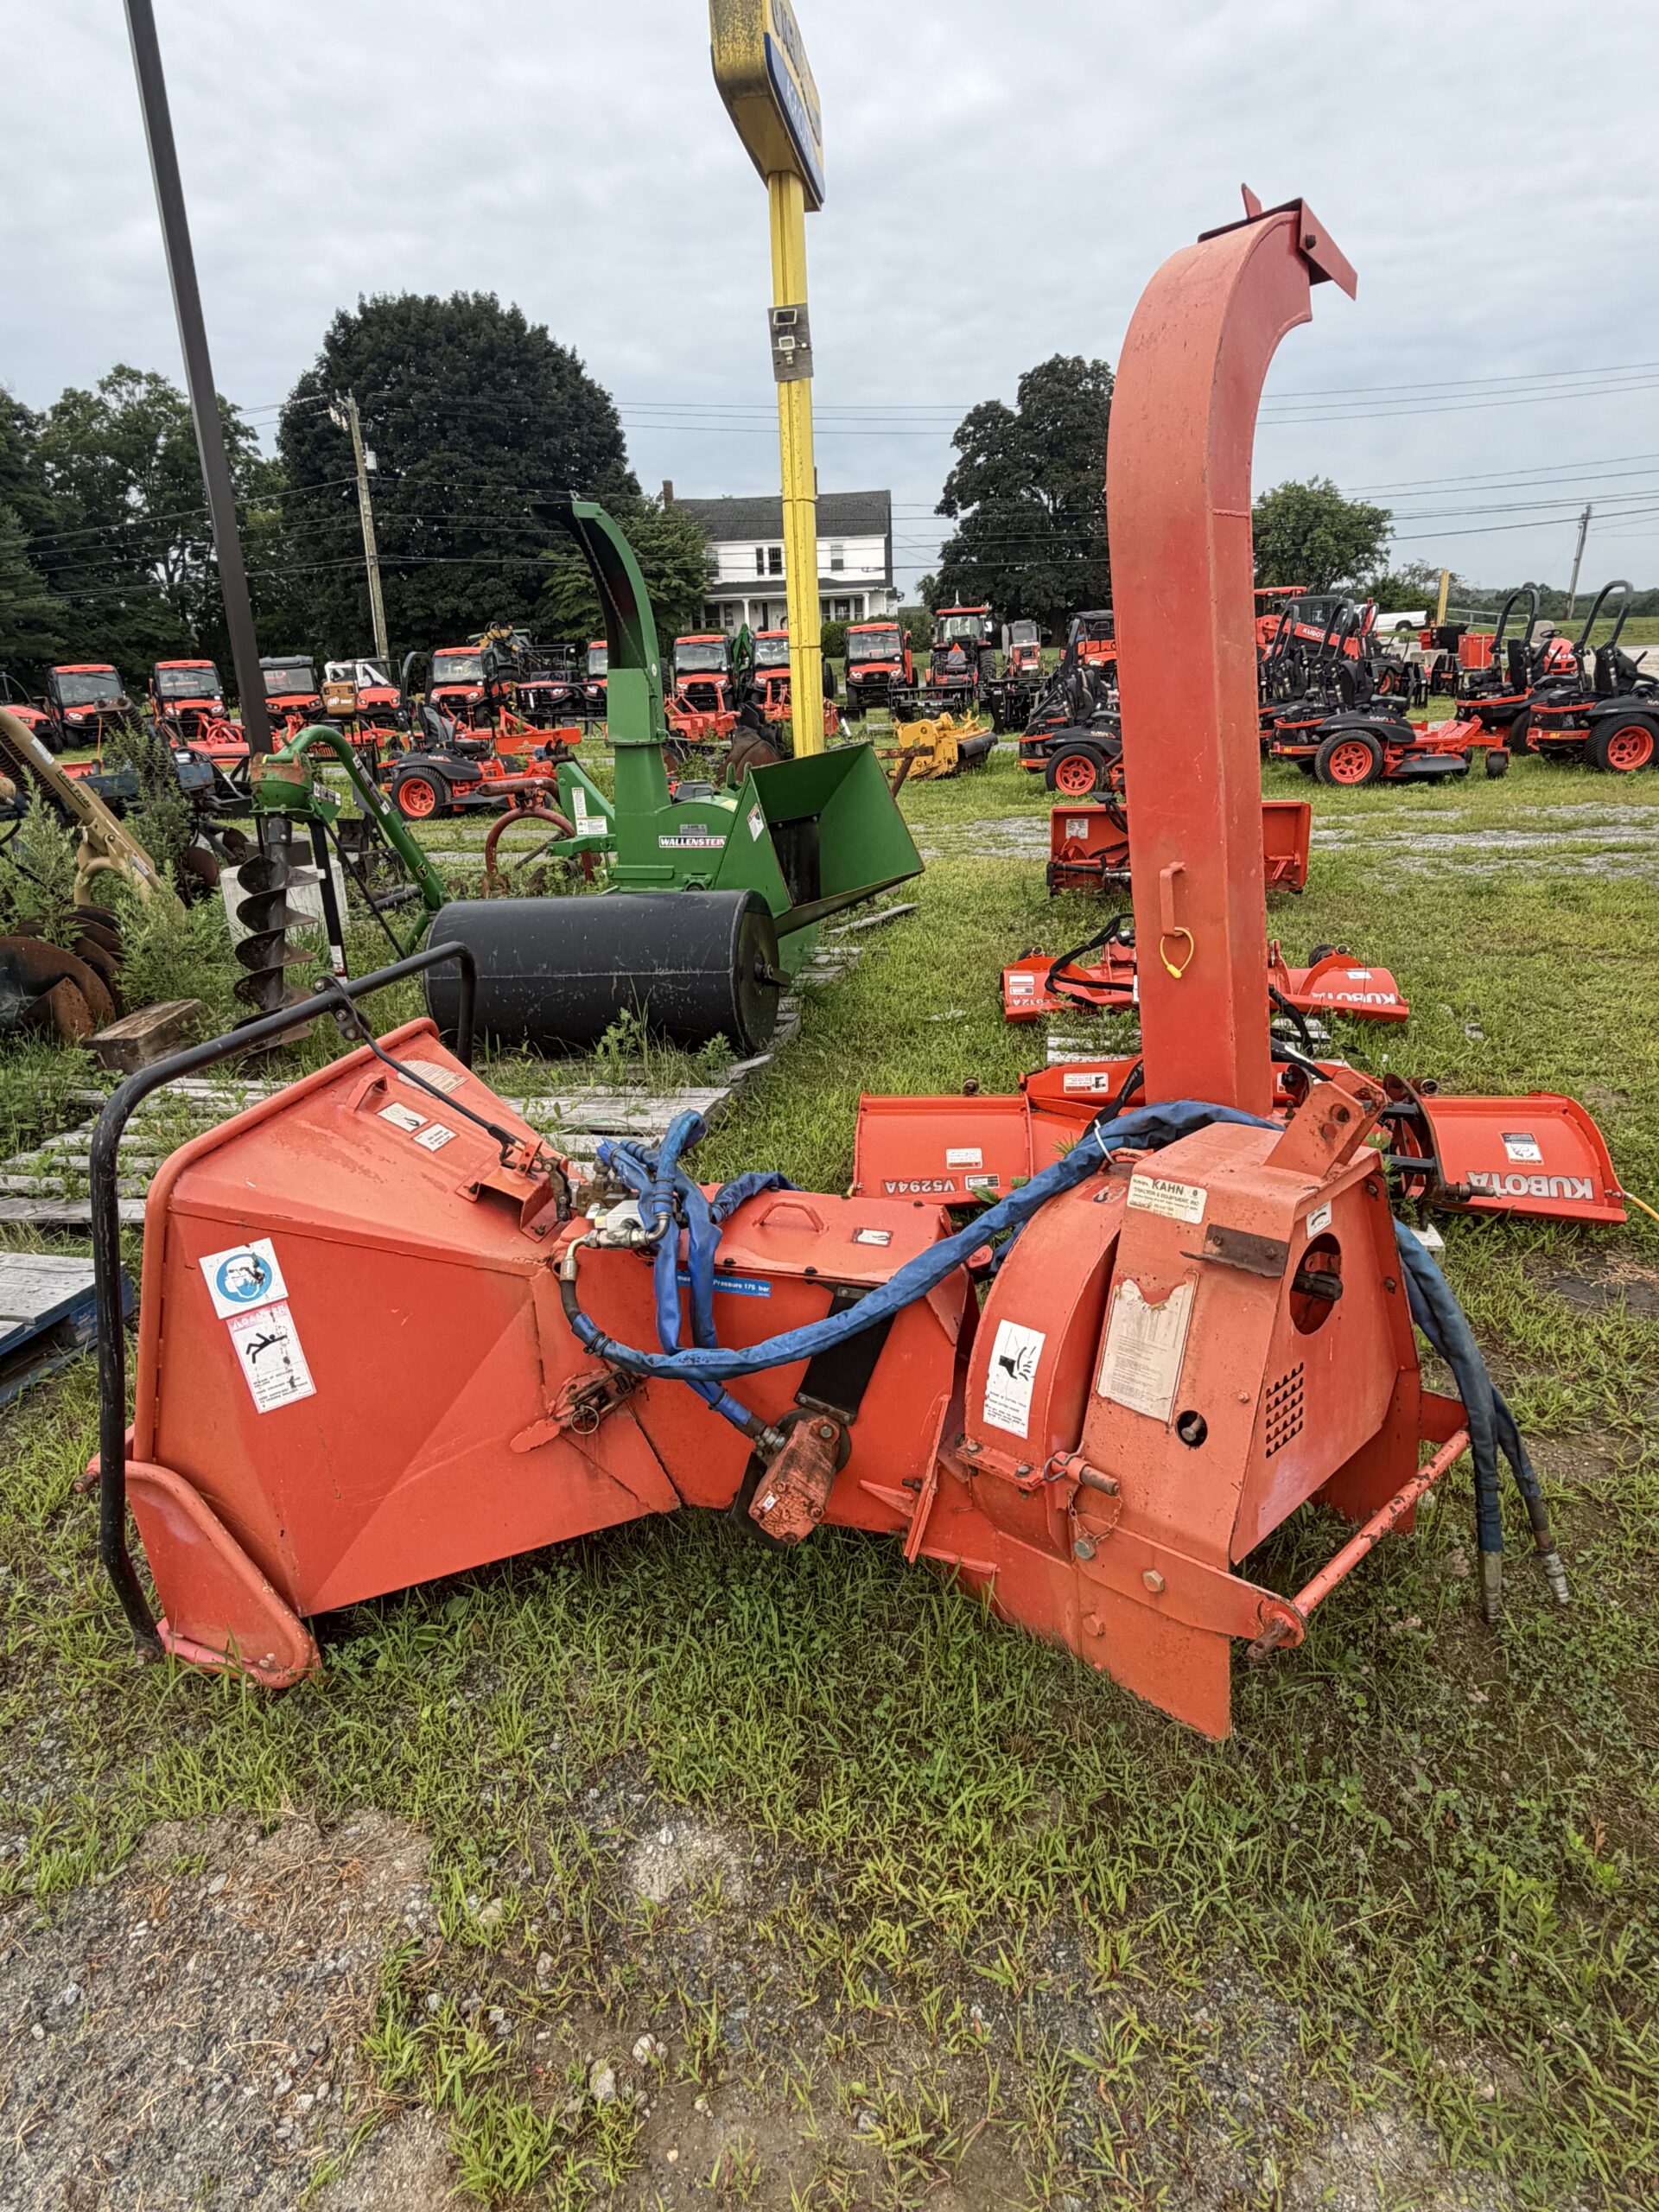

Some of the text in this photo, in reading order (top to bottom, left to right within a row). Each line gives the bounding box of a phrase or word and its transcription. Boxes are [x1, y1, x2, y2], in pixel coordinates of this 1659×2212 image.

[1302, 627, 1325, 639] KUBOT
[884, 1179, 956, 1194] V5294A
[1152, 1180, 1185, 1196] KAHN
[1465, 1171, 1594, 1200] KUBOTA
